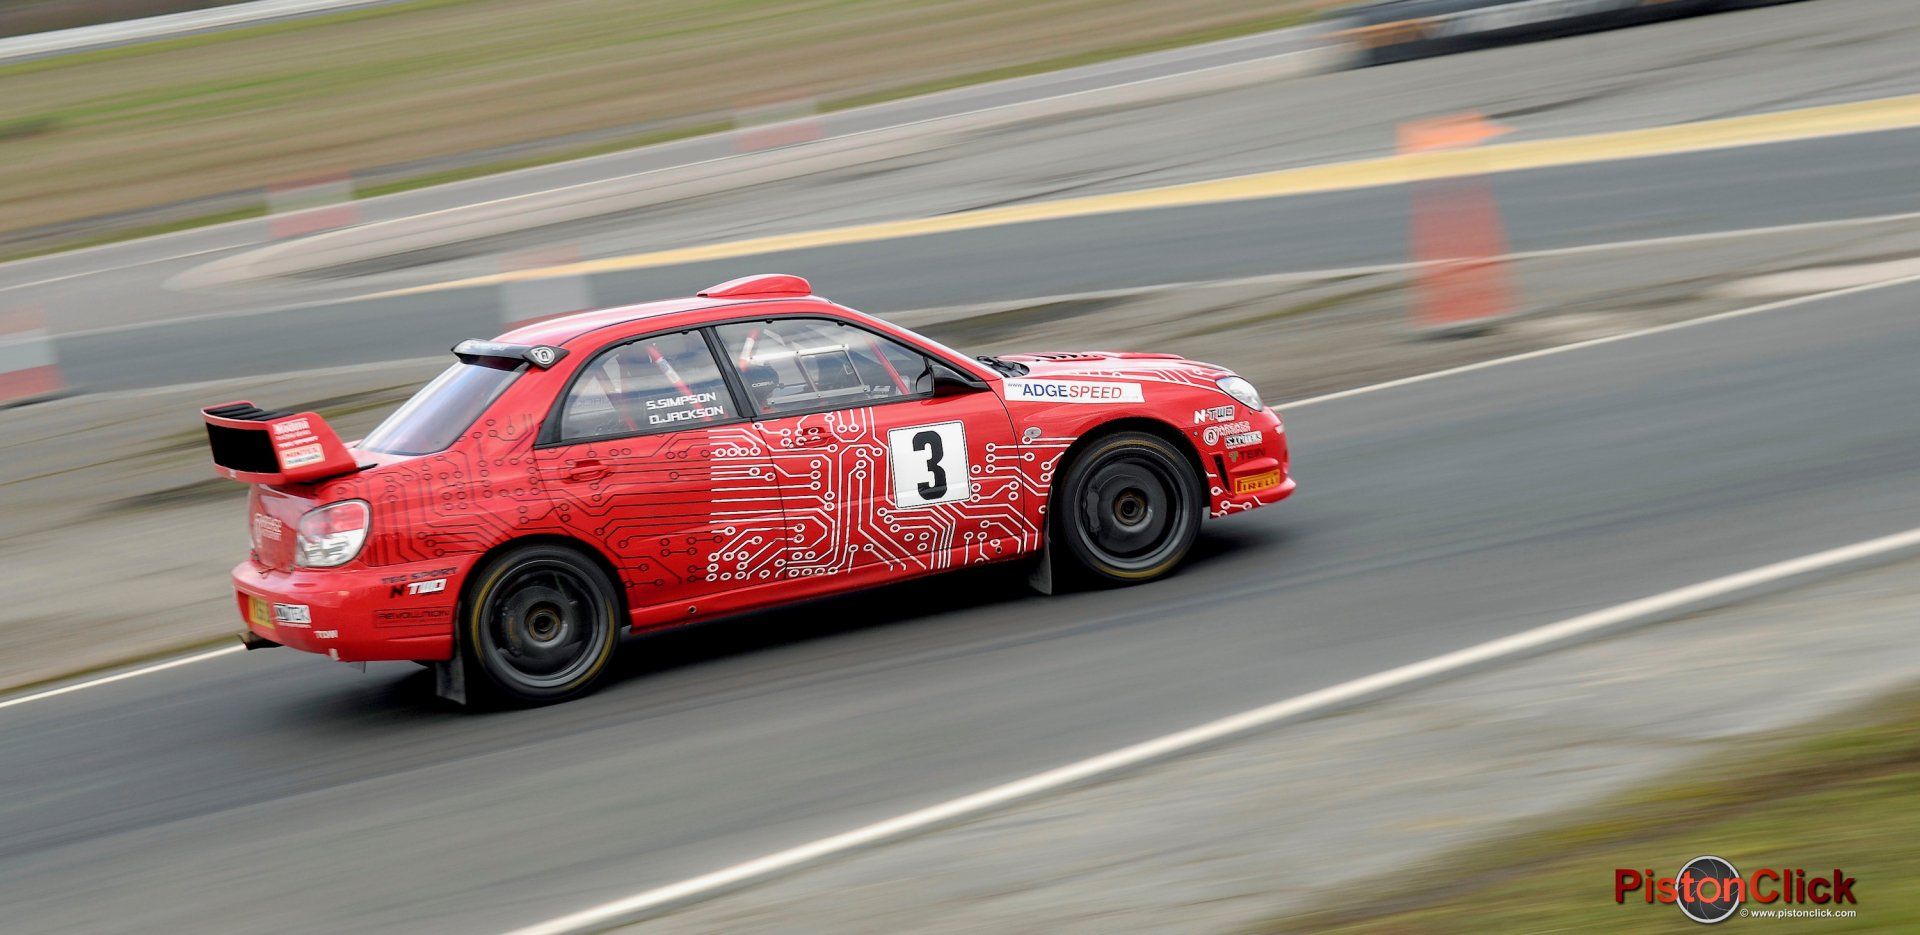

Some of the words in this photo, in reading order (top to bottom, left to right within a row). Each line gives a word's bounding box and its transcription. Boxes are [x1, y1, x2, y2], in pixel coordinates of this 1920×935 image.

[1023, 384, 1122, 399] ADGESPEED
[646, 392, 716, 410] S.SIMPSON
[649, 406, 724, 425] D.JACKSON
[912, 430, 948, 500] 3
